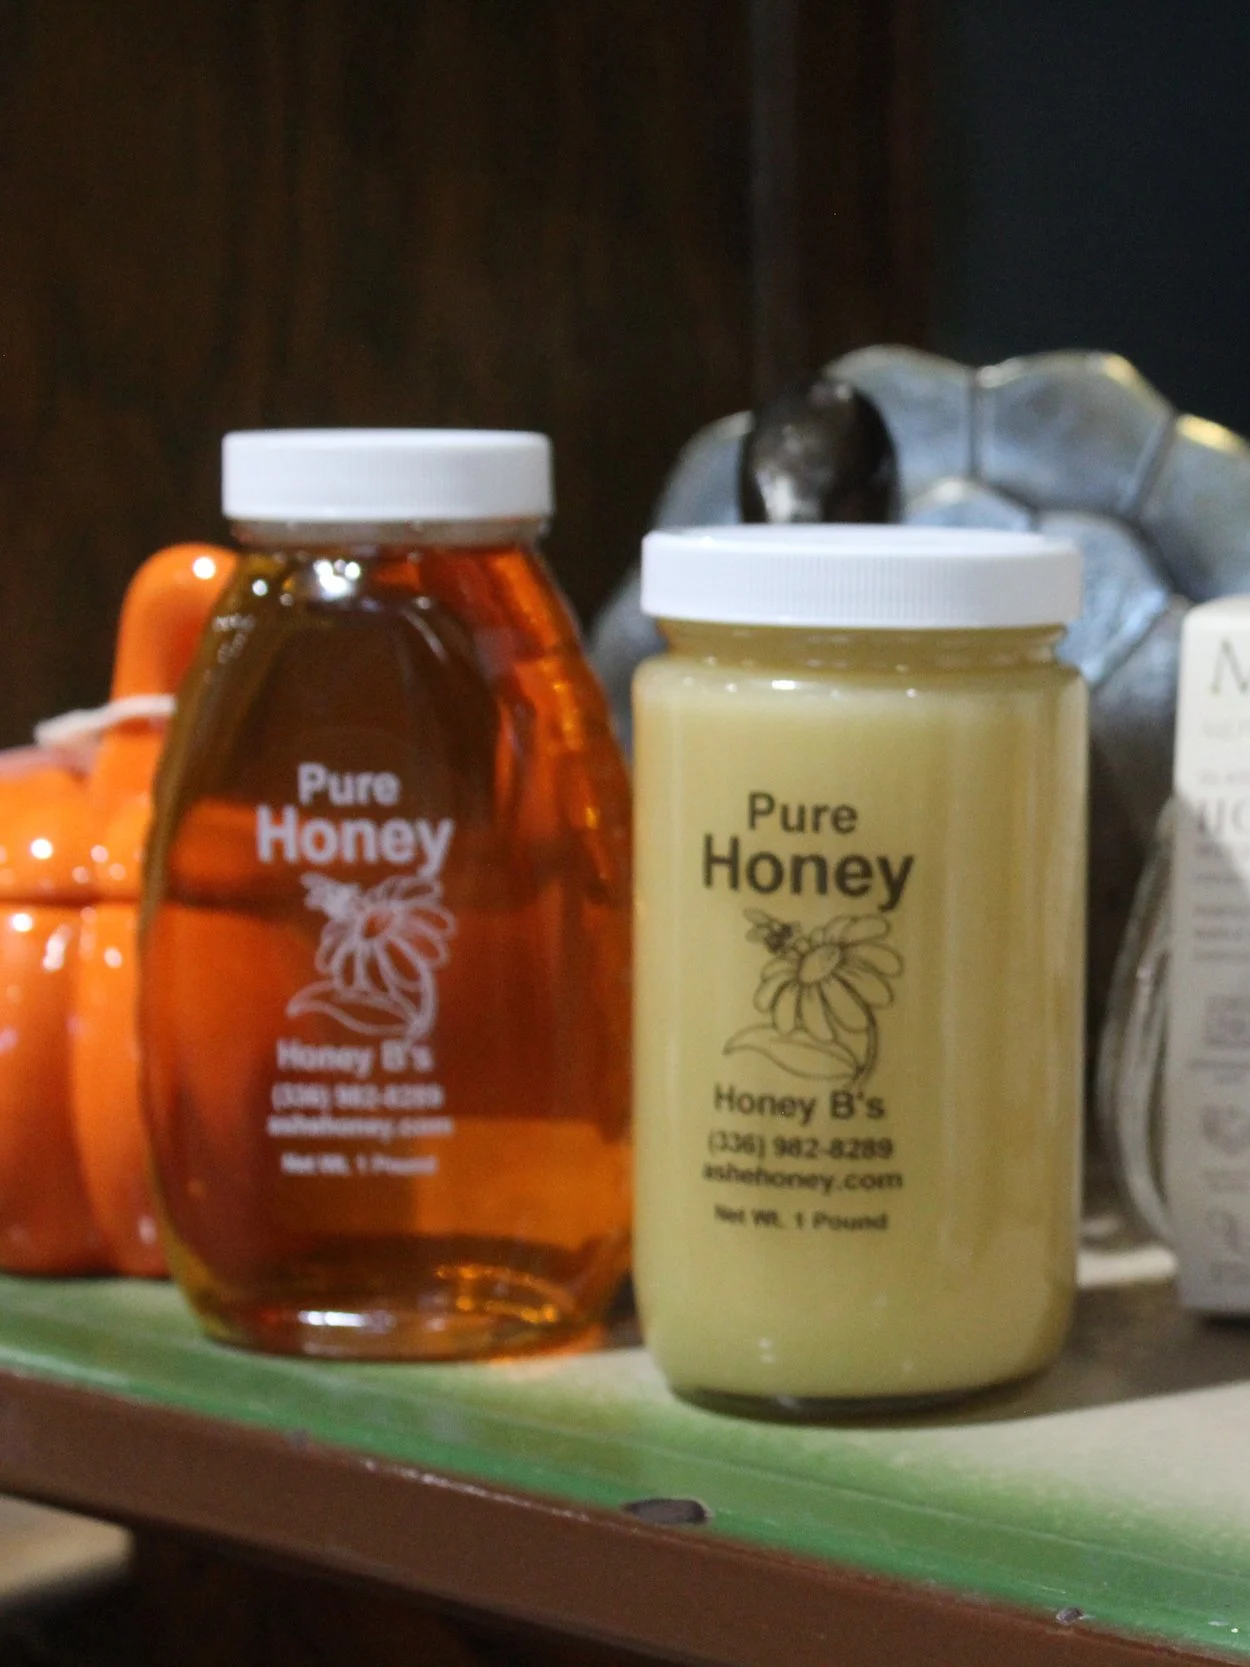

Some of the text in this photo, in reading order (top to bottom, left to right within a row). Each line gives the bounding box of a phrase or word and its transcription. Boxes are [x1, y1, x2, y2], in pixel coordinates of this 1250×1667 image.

[298, 762, 400, 805] Pure
[747, 792, 860, 834] Pure
[256, 804, 457, 878] Honey
[703, 832, 915, 912] Honey
[714, 1083, 887, 1127] Honey B's
